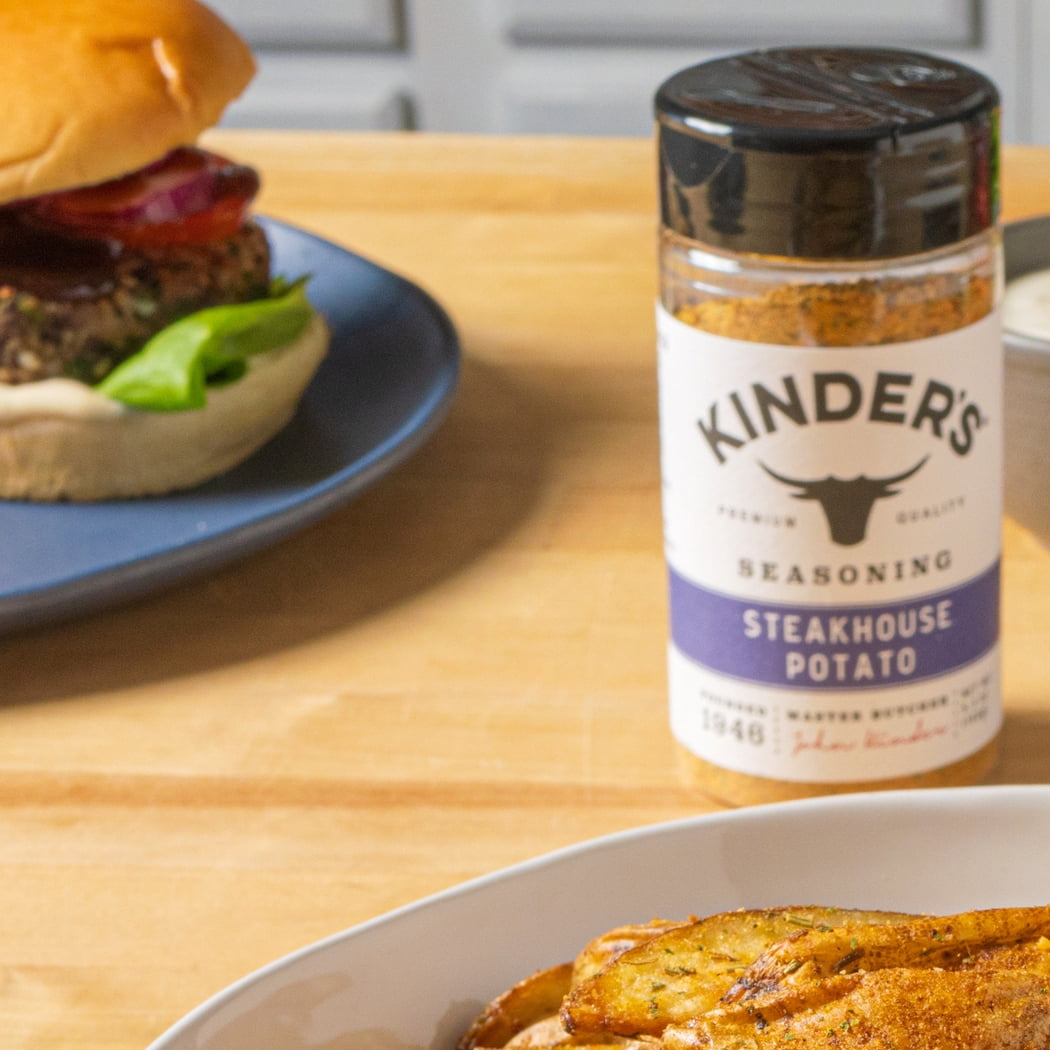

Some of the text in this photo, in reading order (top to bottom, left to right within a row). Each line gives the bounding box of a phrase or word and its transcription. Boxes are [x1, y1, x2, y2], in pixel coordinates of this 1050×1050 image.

[697, 371, 982, 465] KINDER'S
[738, 551, 952, 585] SEASONING
[743, 600, 953, 645] STEAKHOUSE
[786, 647, 917, 682] POTATO
